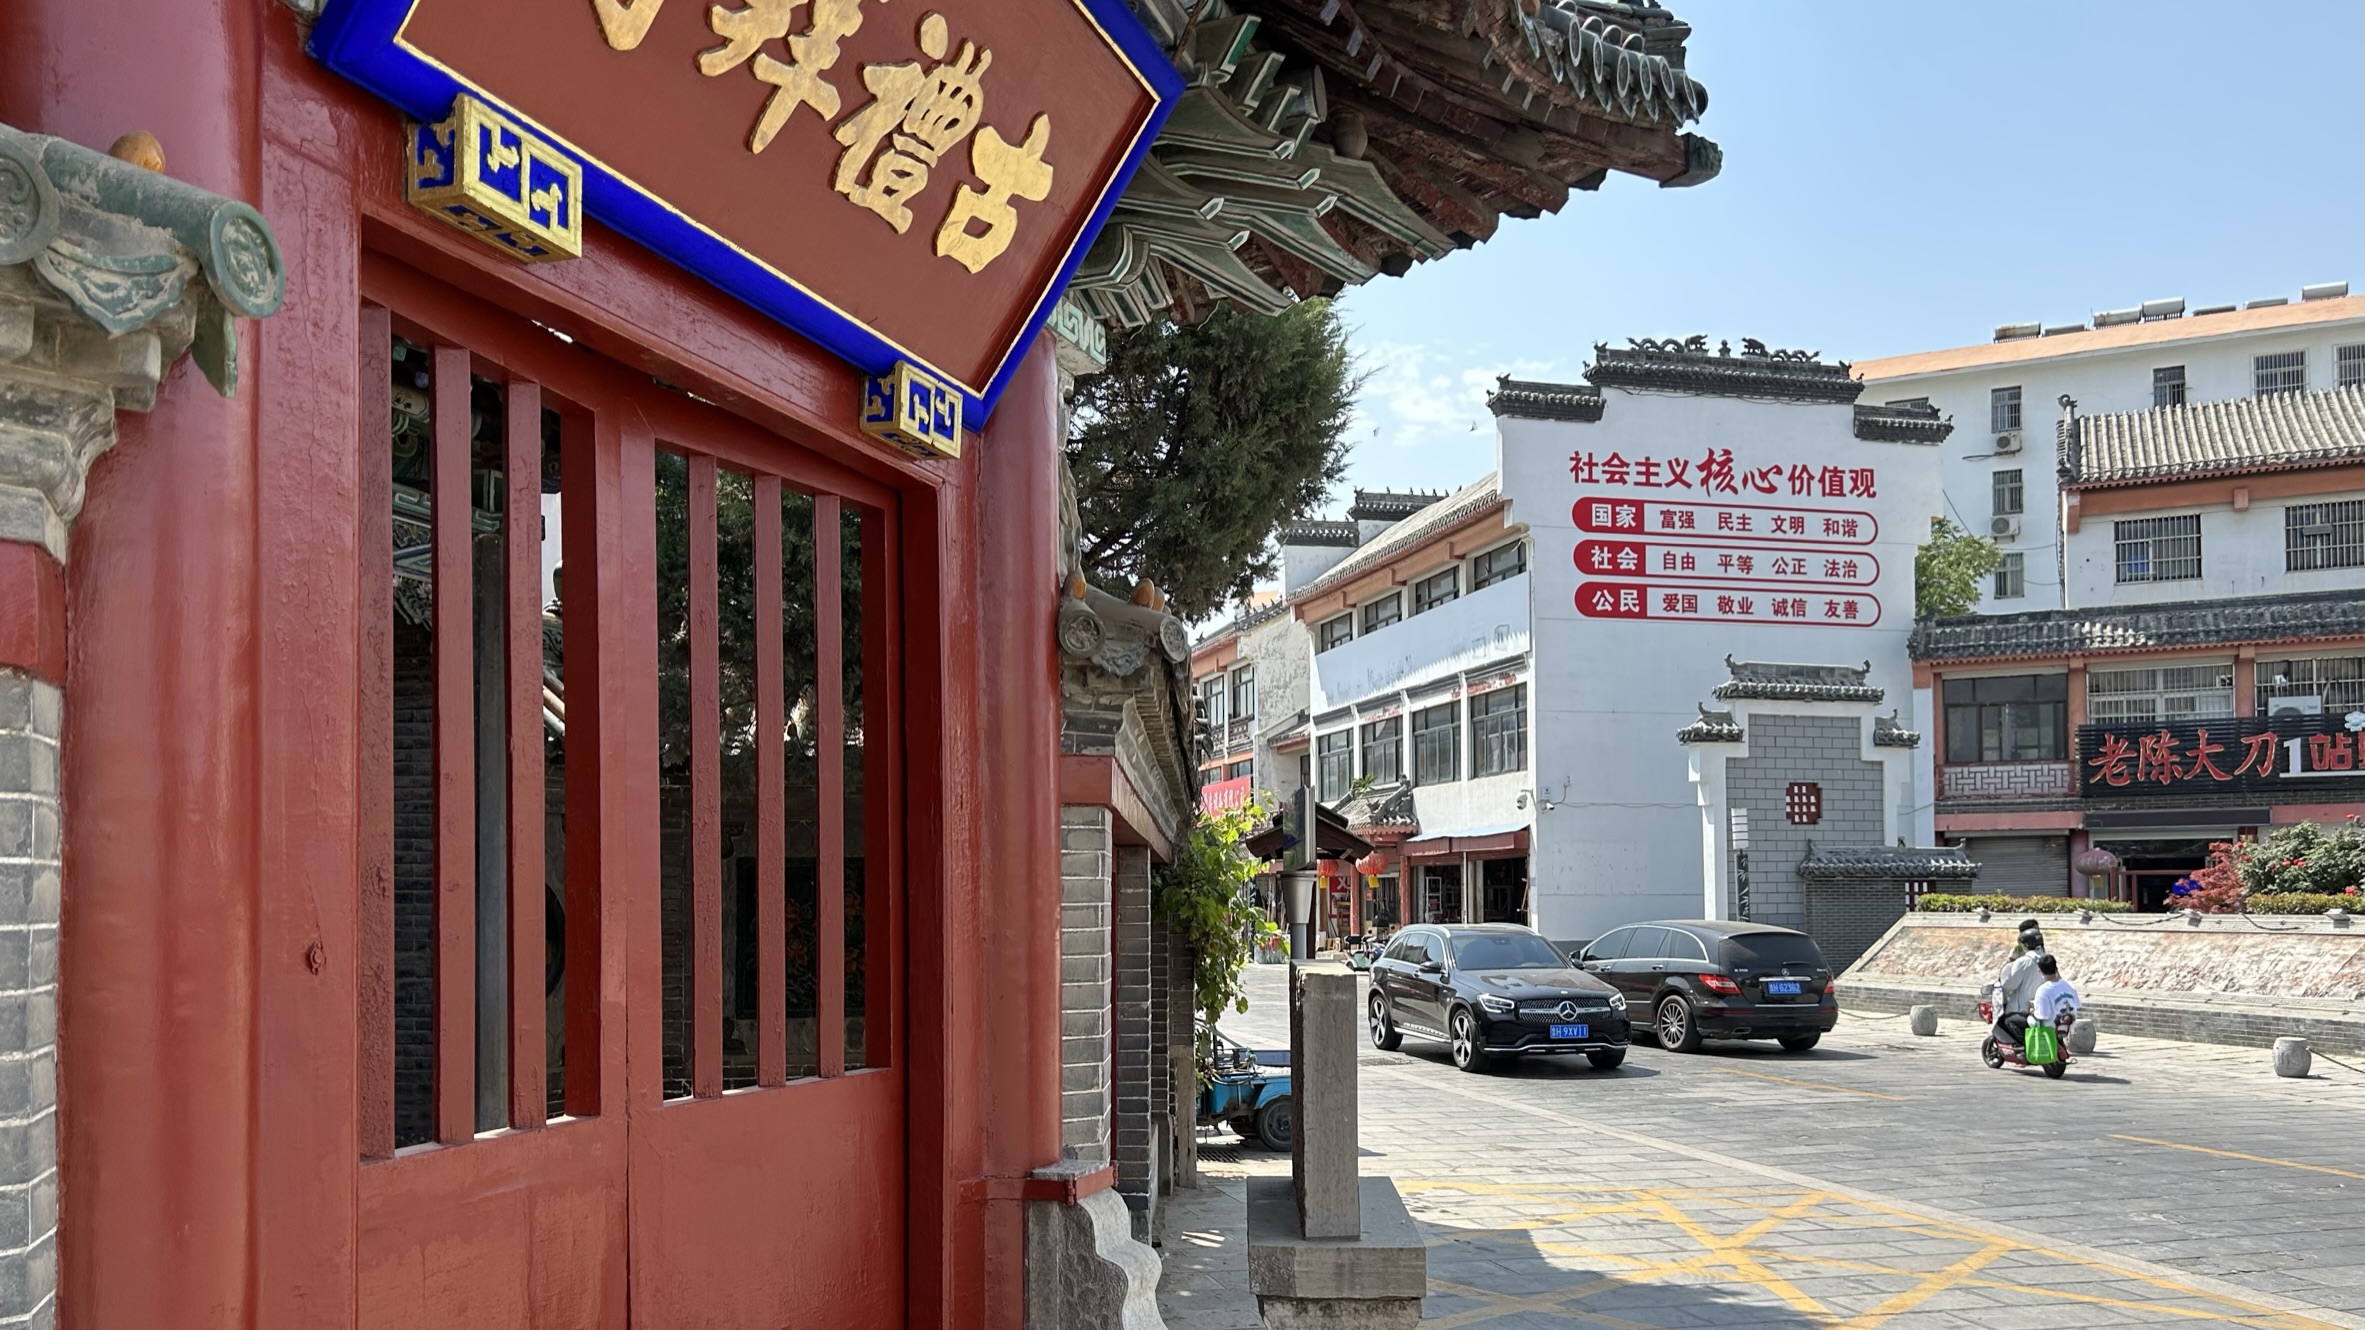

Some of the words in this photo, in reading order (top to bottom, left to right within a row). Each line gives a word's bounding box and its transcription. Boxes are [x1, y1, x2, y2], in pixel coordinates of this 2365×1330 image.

[1569, 448, 1877, 498] 社会主义核心价值观
[1592, 503, 1637, 528] 国家
[1660, 509, 1695, 530] 富强
[1718, 512, 1753, 532] 民主
[1771, 515, 1805, 535] 文明
[1823, 518, 1858, 538] 和谐
[1591, 545, 1639, 571] 社会
[1663, 551, 1695, 572] 自由
[1717, 554, 1754, 575] 平等
[1772, 556, 1808, 576] 公正
[1824, 559, 1858, 579] 法治
[1592, 589, 1640, 613] 公民
[1663, 593, 1698, 614] 爱国
[1717, 595, 1754, 615] 敬业
[1772, 598, 1807, 618] 诚信
[1824, 600, 1859, 619] 友善
